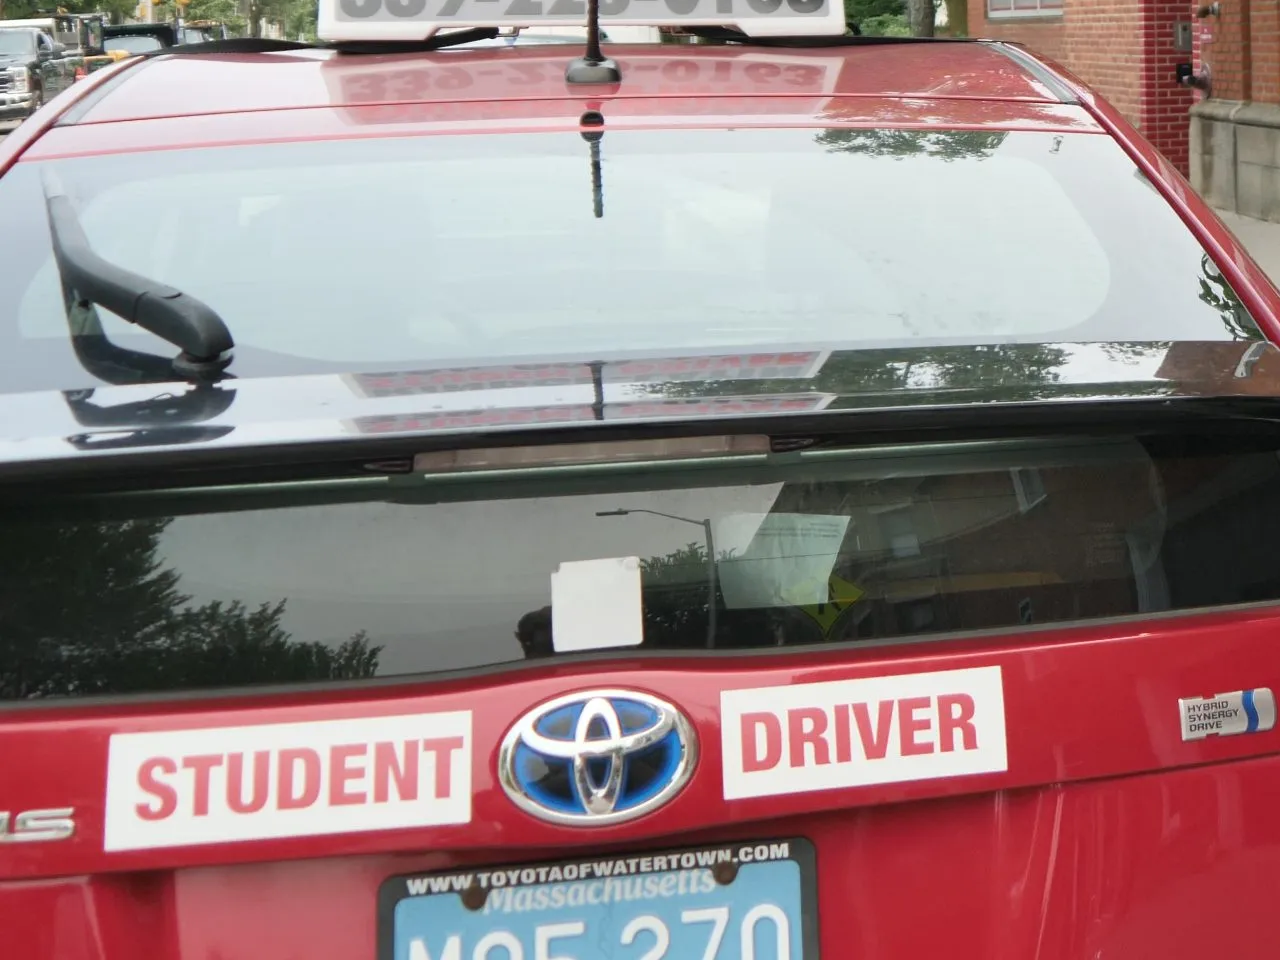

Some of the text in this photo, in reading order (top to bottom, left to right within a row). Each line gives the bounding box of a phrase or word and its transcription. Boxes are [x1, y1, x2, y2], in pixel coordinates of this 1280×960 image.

[1187, 700, 1229, 713] HYBRID
[1188, 708, 1239, 723] SYNERGY
[1189, 721, 1222, 732] DRIVE
[134, 692, 980, 822] STUDENT DRIVER
[481, 868, 717, 916] Massachusetts
